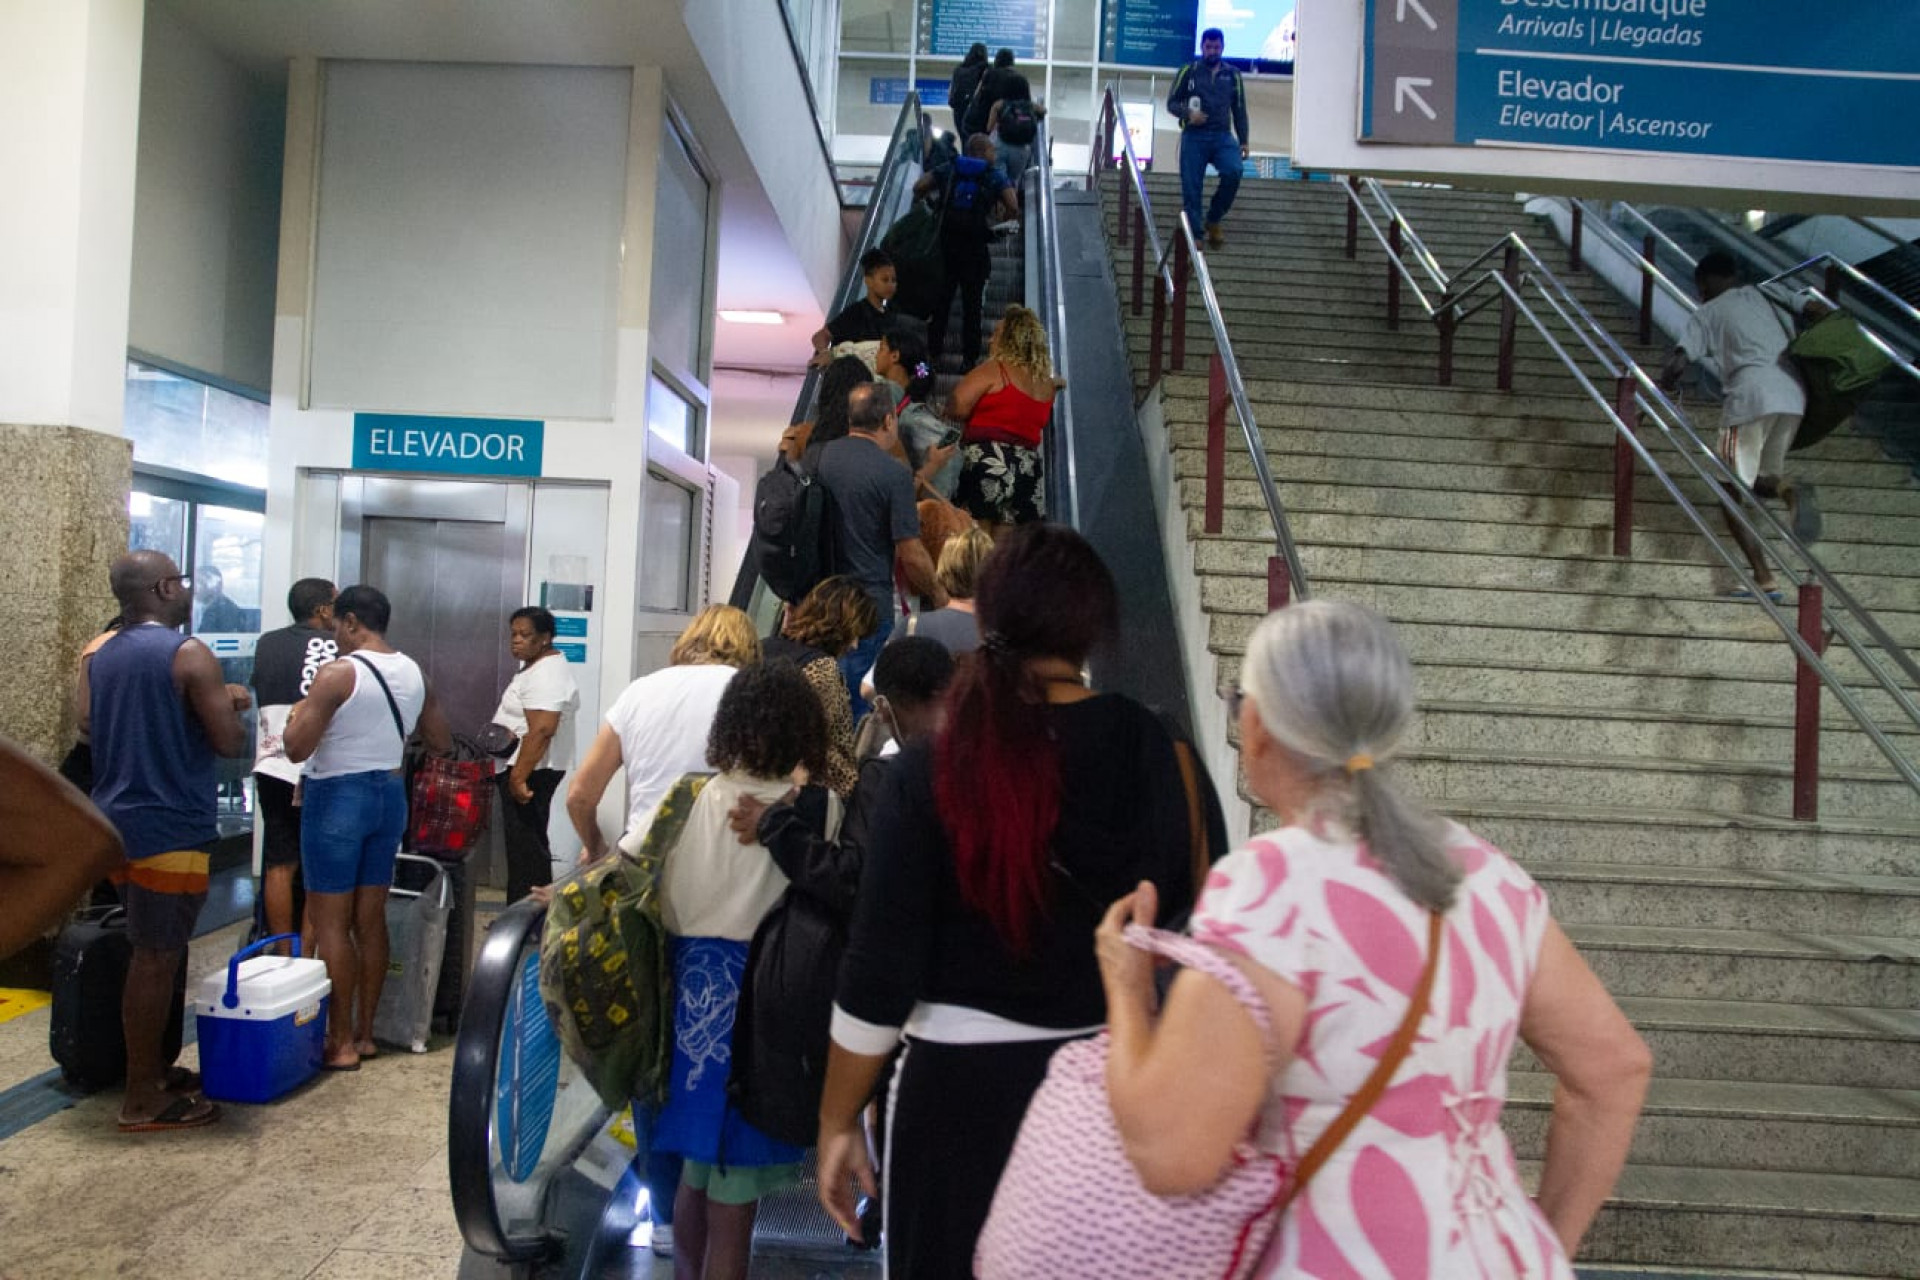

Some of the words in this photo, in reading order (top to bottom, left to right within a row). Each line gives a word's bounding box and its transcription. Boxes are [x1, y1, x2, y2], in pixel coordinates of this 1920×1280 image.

[1500, 0, 1706, 22] marque
[1497, 13, 1585, 39] Arrivals
[1600, 17, 1703, 48] Llegadas
[1497, 69, 1625, 104] Elevador
[1499, 104, 1595, 131] Elevator
[1608, 112, 1713, 139] Ascensor
[370, 428, 524, 462] ELEVADOR
